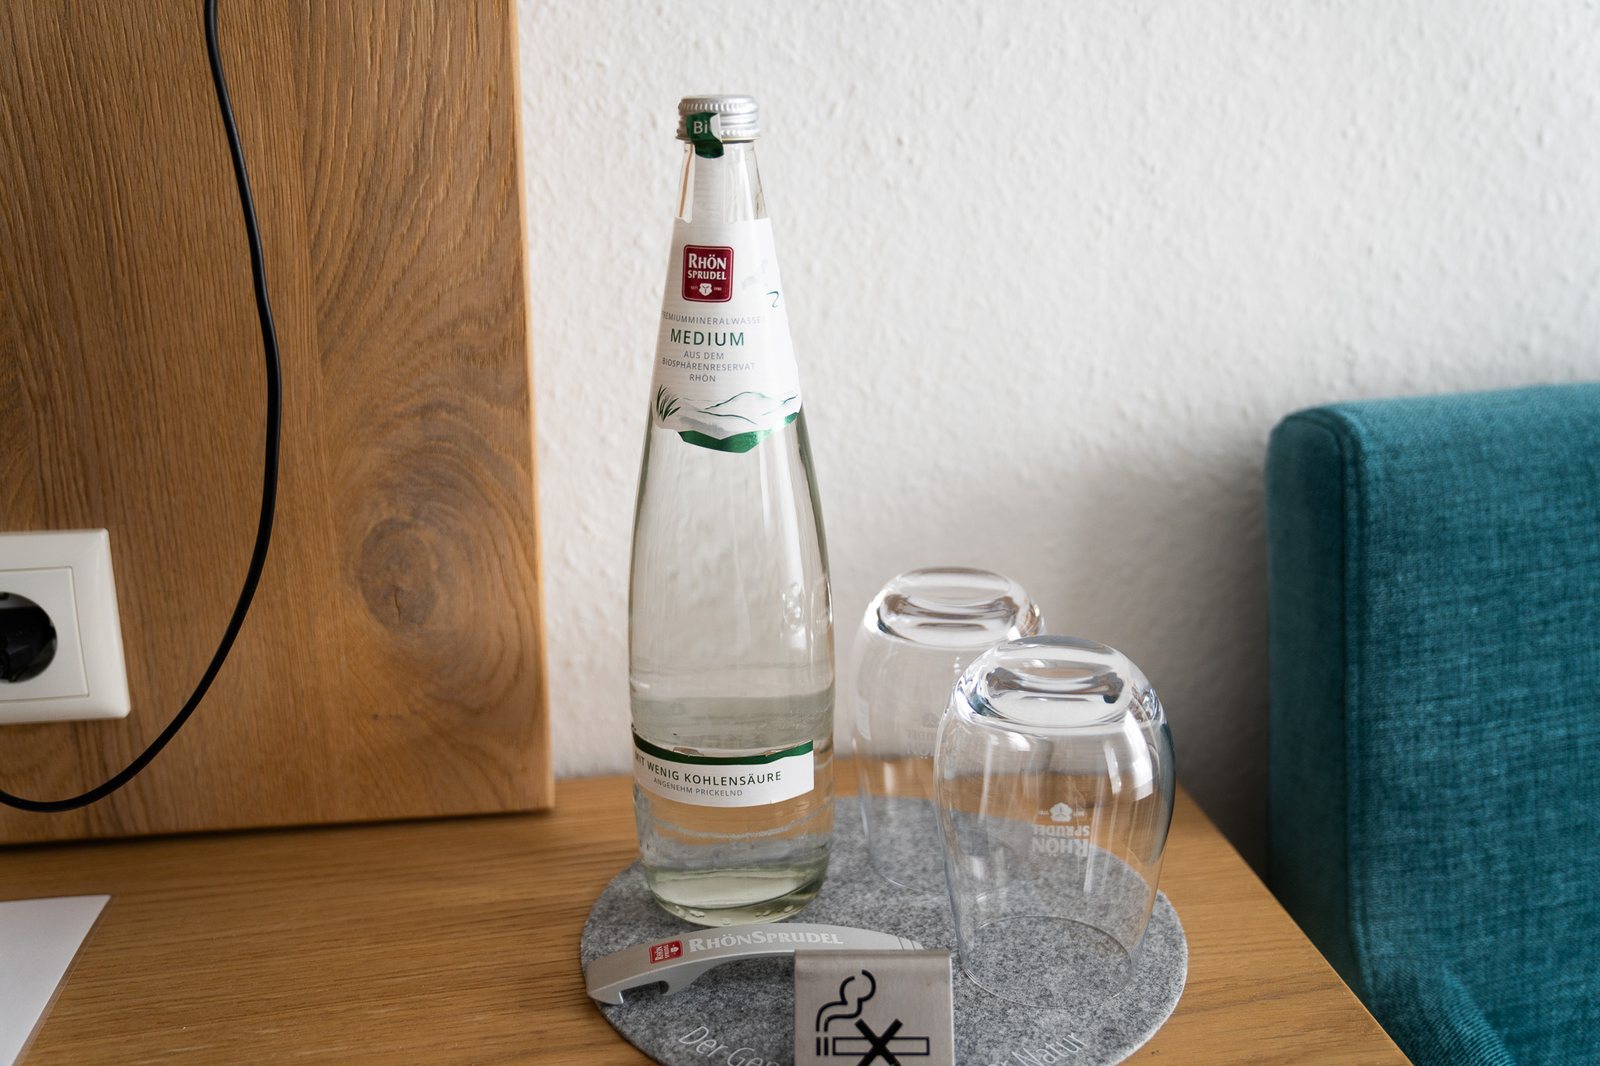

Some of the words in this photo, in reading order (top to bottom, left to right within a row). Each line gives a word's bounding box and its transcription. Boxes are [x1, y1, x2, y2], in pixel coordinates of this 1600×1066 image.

[688, 253, 727, 270] RHÖN
[687, 270, 727, 280] SPRUDEL
[670, 328, 744, 346] MEDIUM
[683, 350, 701, 359] AUS
[703, 352, 725, 360] DEM
[647, 760, 680, 781] WENIG
[684, 771, 782, 786] KOHLENSÄURE
[653, 777, 693, 794] ANGENEHM
[695, 788, 743, 797] PRICKELND
[678, 1026, 729, 1058] Der
[1011, 1032, 1088, 1066] Natur
